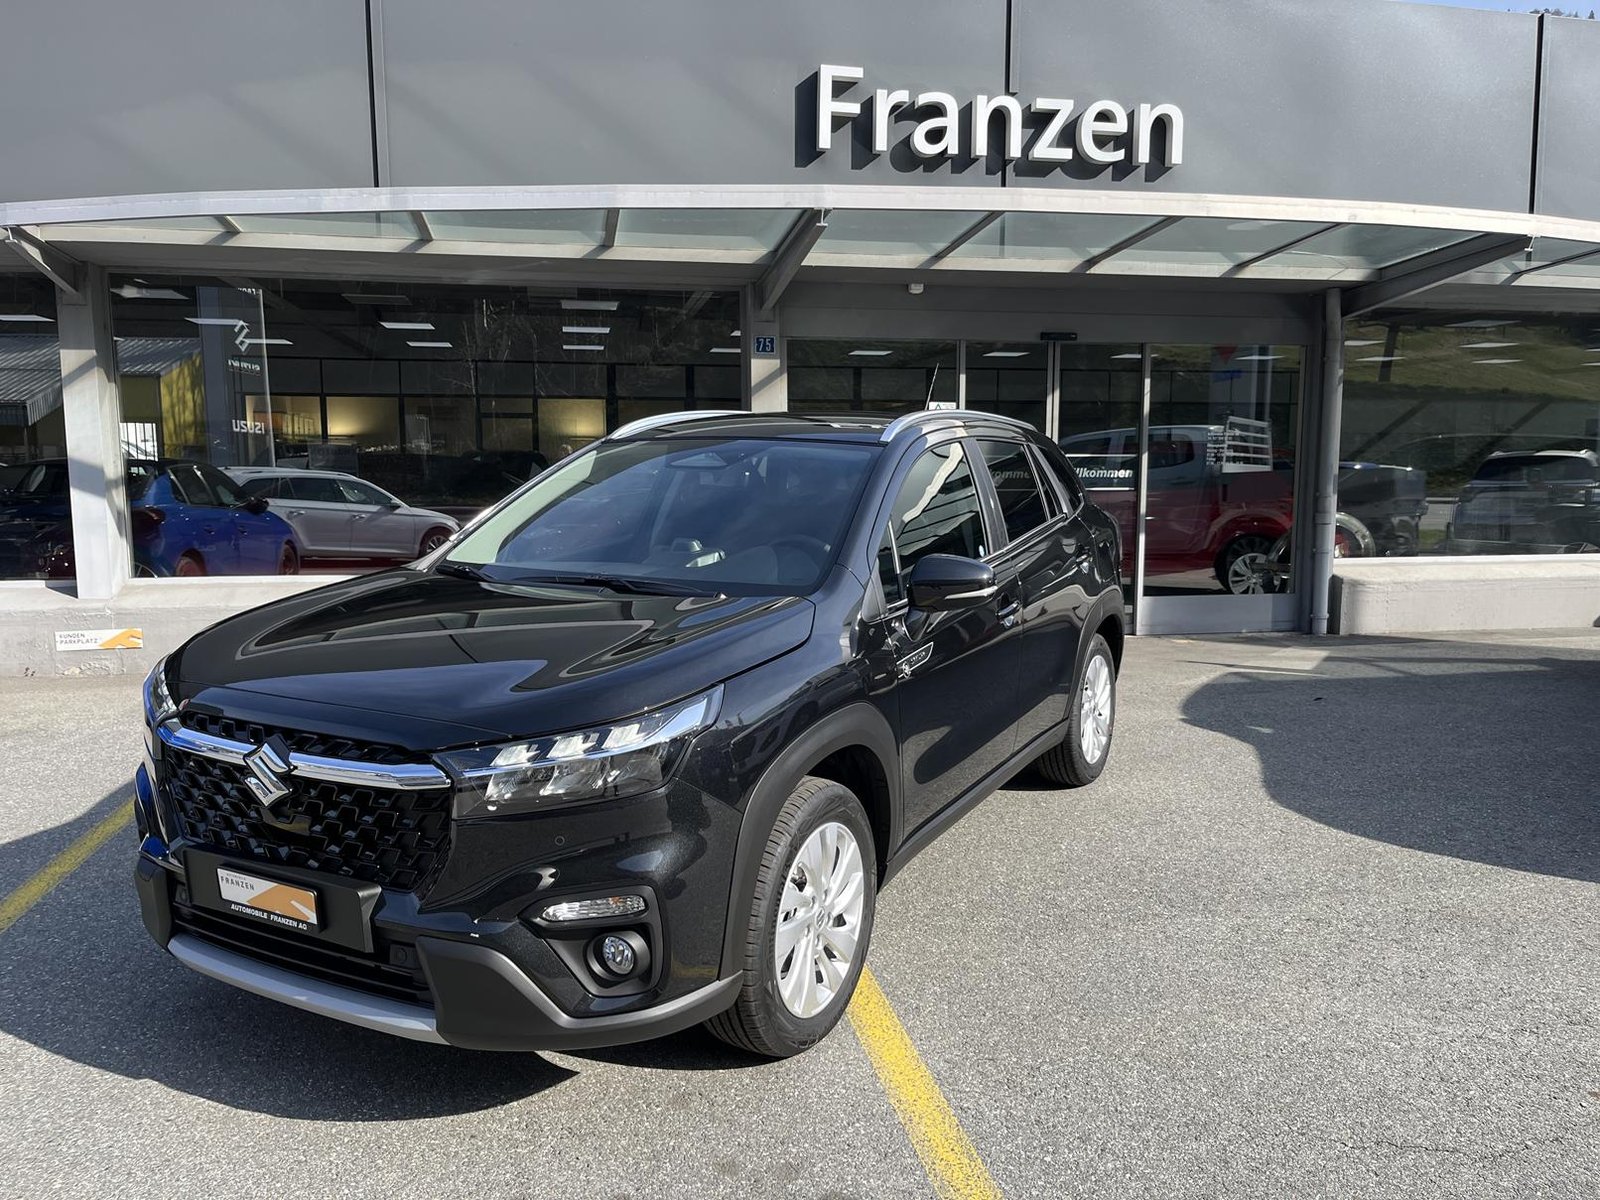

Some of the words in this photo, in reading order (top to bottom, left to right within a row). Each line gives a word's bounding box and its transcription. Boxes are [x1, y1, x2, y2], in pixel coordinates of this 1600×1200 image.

[816, 64, 1184, 167] Franzen
[759, 338, 771, 351] 75
[1074, 467, 1133, 478] llkommen
[220, 876, 255, 891] FRANZEN
[230, 903, 268, 919] AUTOMOBILE
[270, 914, 298, 928] FRANZEN
